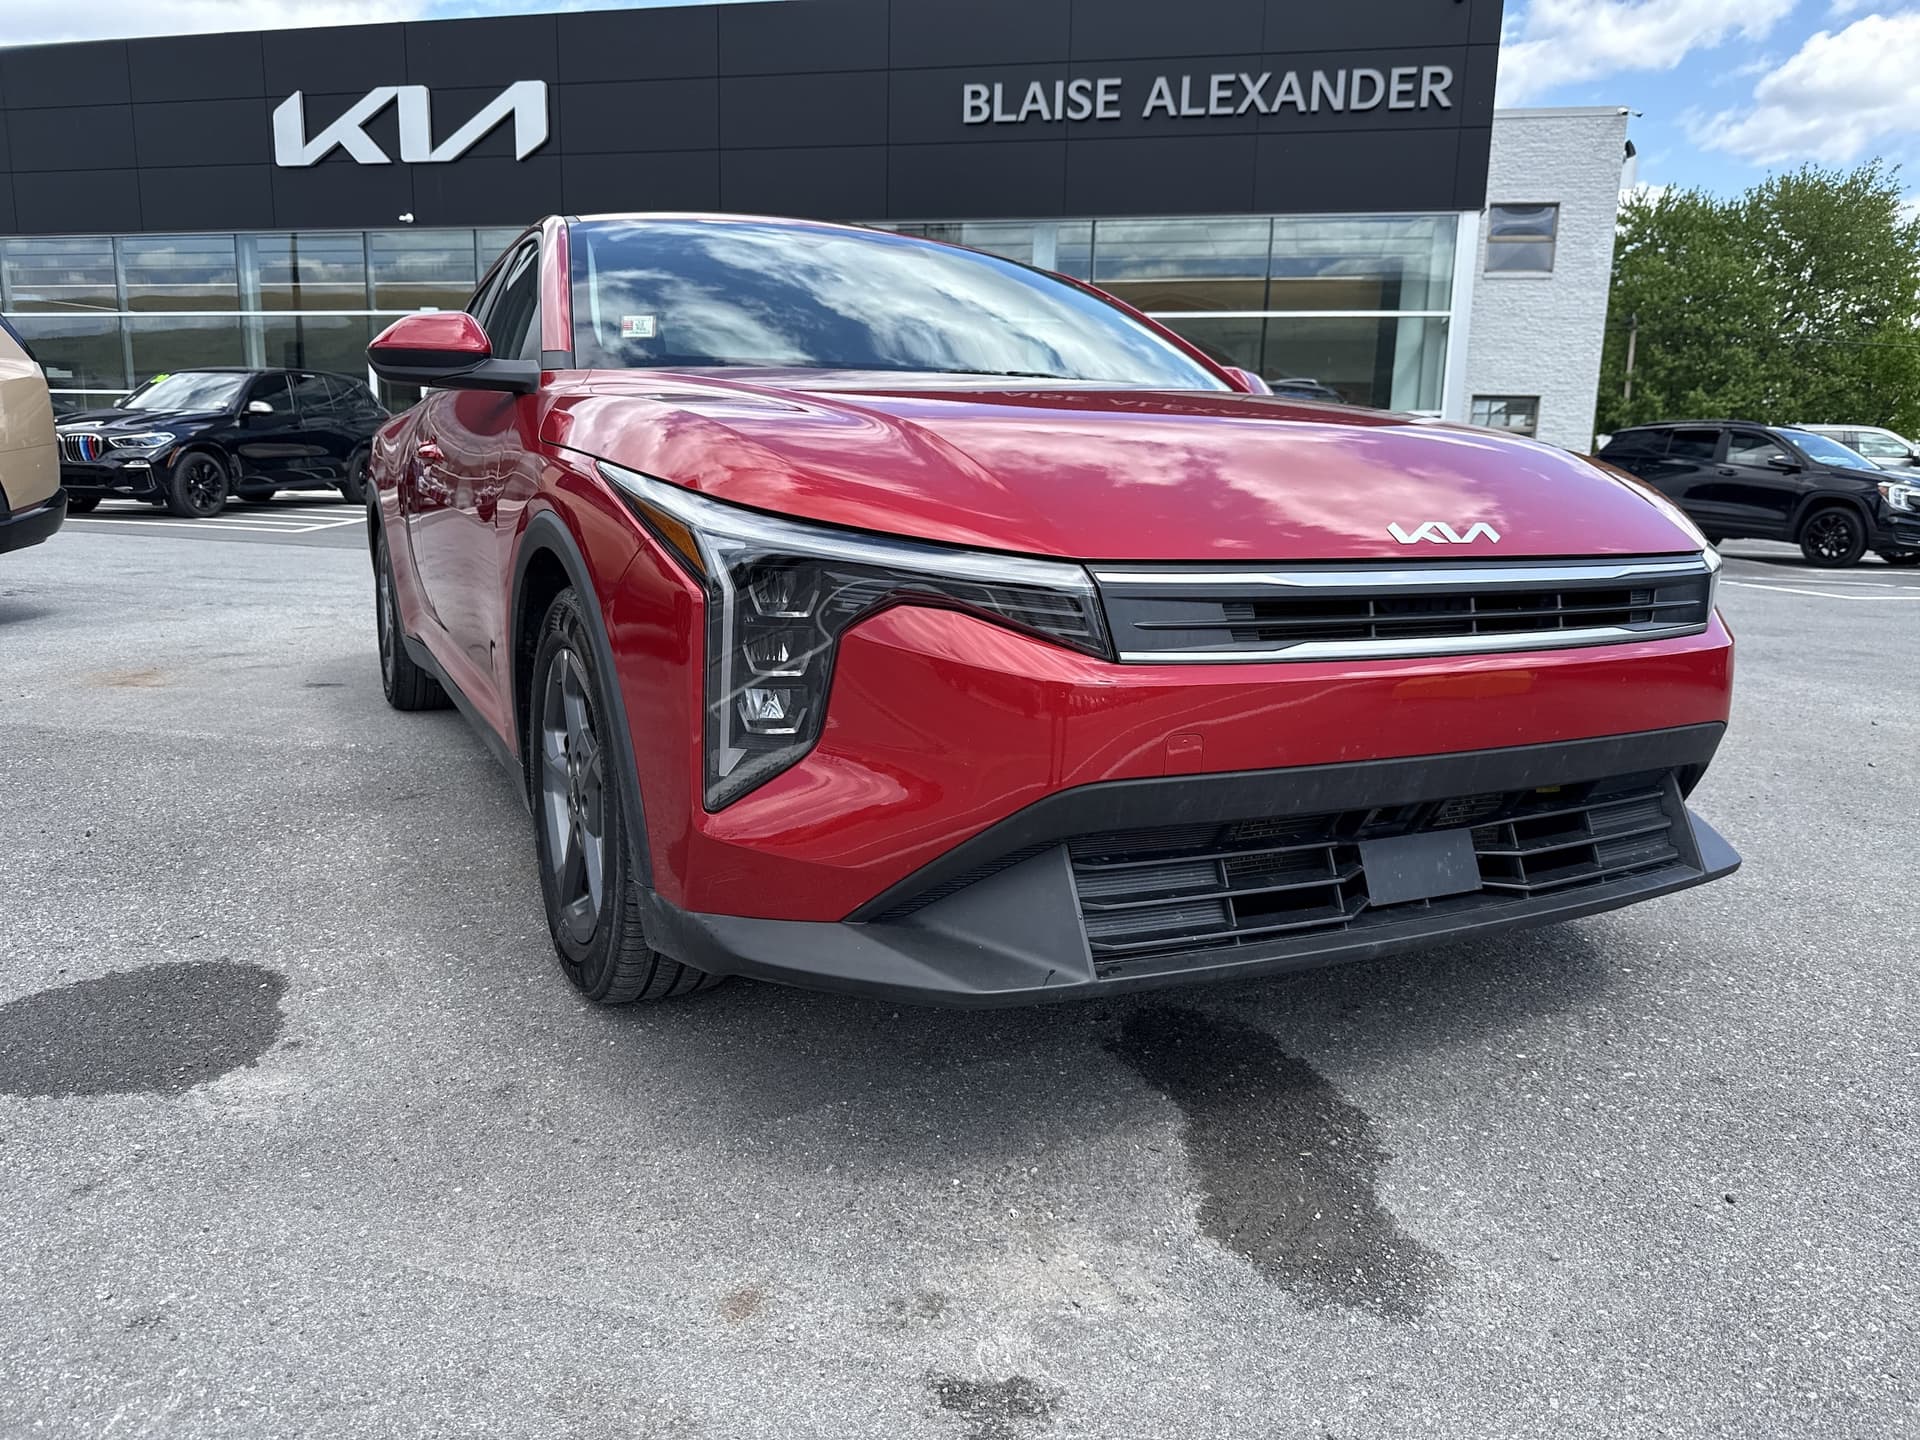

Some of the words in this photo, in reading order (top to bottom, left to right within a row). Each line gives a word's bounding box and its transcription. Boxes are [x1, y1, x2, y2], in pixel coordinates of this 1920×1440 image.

[963, 77, 1122, 123] BLAISE
[1142, 65, 1454, 118] ALEXANDER
[273, 80, 549, 167] KIA
[1386, 521, 1501, 544] KIA
